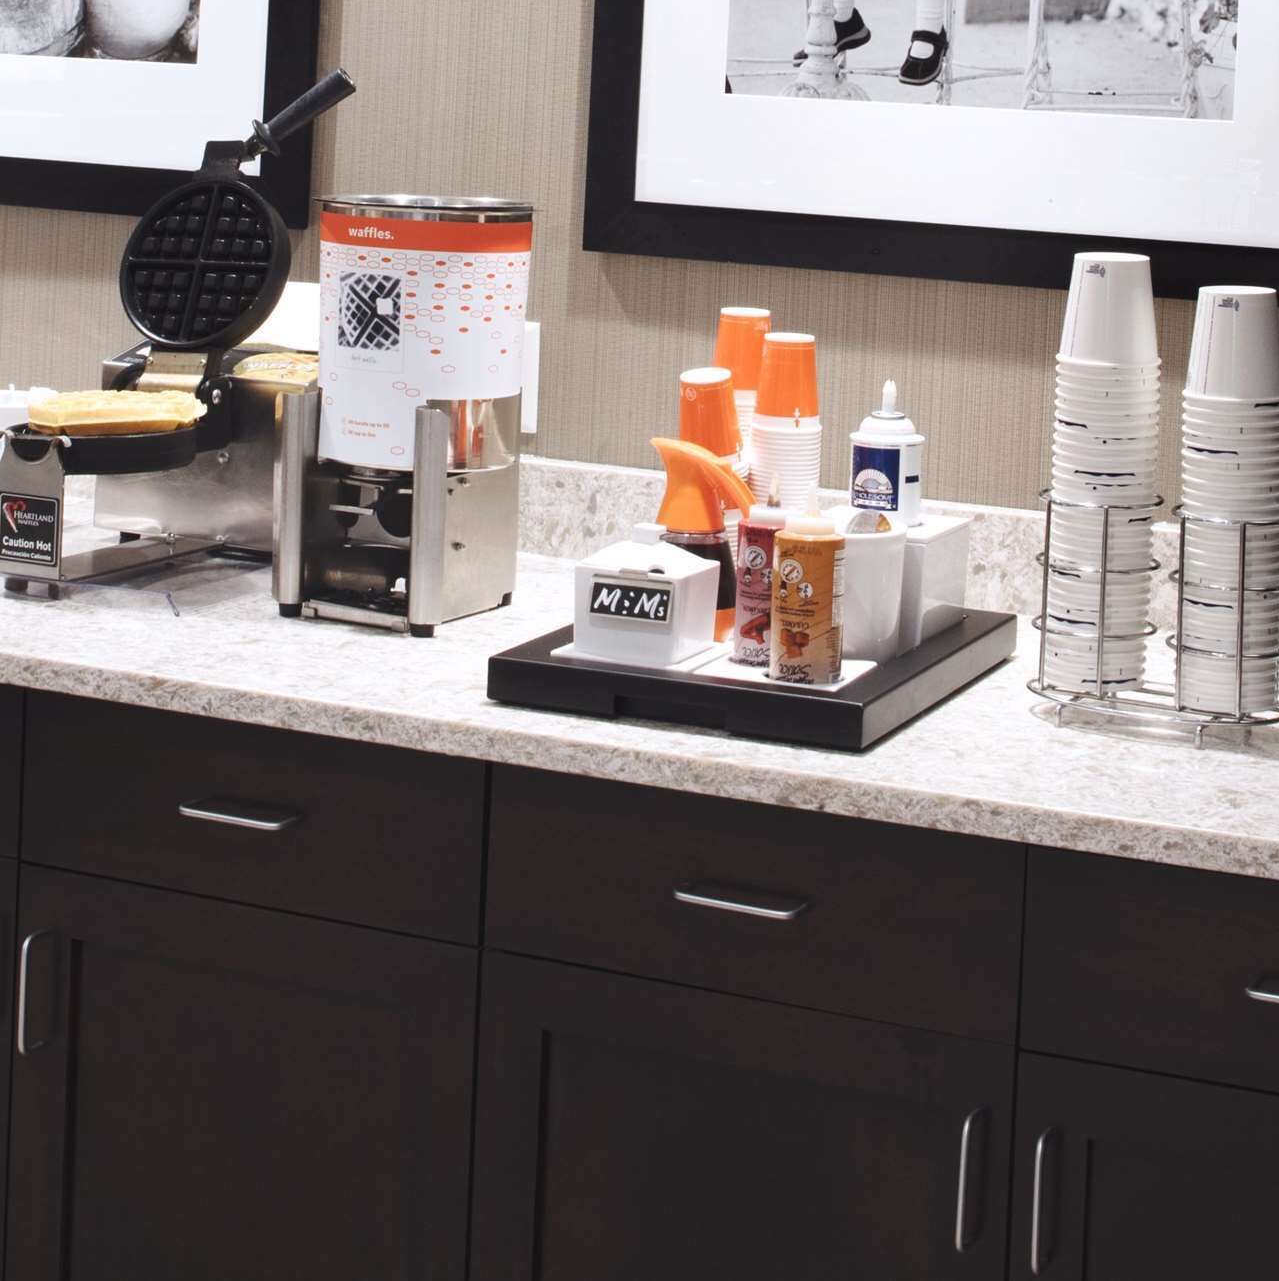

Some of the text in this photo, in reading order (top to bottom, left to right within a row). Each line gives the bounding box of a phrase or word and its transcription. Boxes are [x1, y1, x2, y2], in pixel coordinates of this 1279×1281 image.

[348, 226, 395, 240] waffles.
[13, 510, 54, 523] HEARTLAND
[2, 535, 52, 552] Caution Hot
